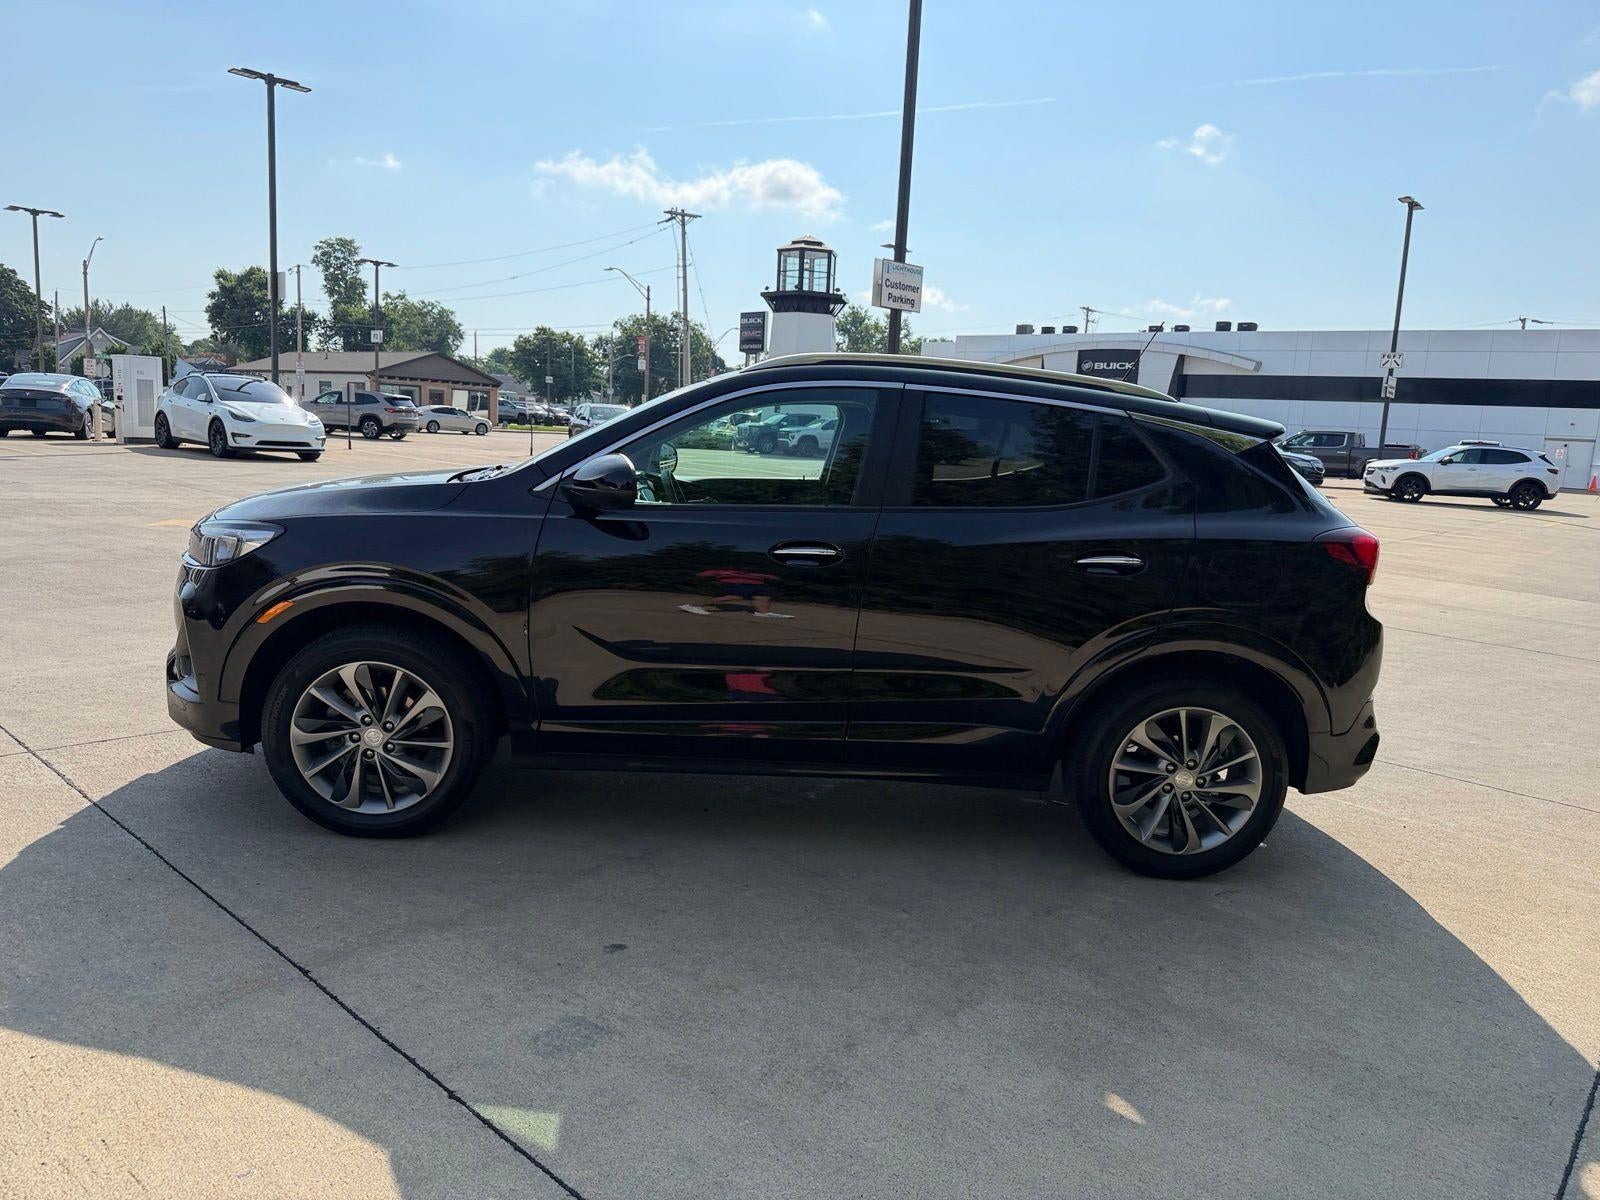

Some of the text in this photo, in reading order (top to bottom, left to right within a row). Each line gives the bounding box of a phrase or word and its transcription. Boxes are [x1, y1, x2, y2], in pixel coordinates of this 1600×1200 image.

[885, 278, 920, 294] Customer
[887, 292, 915, 308] Parking
[1093, 361, 1136, 370] BUICK
